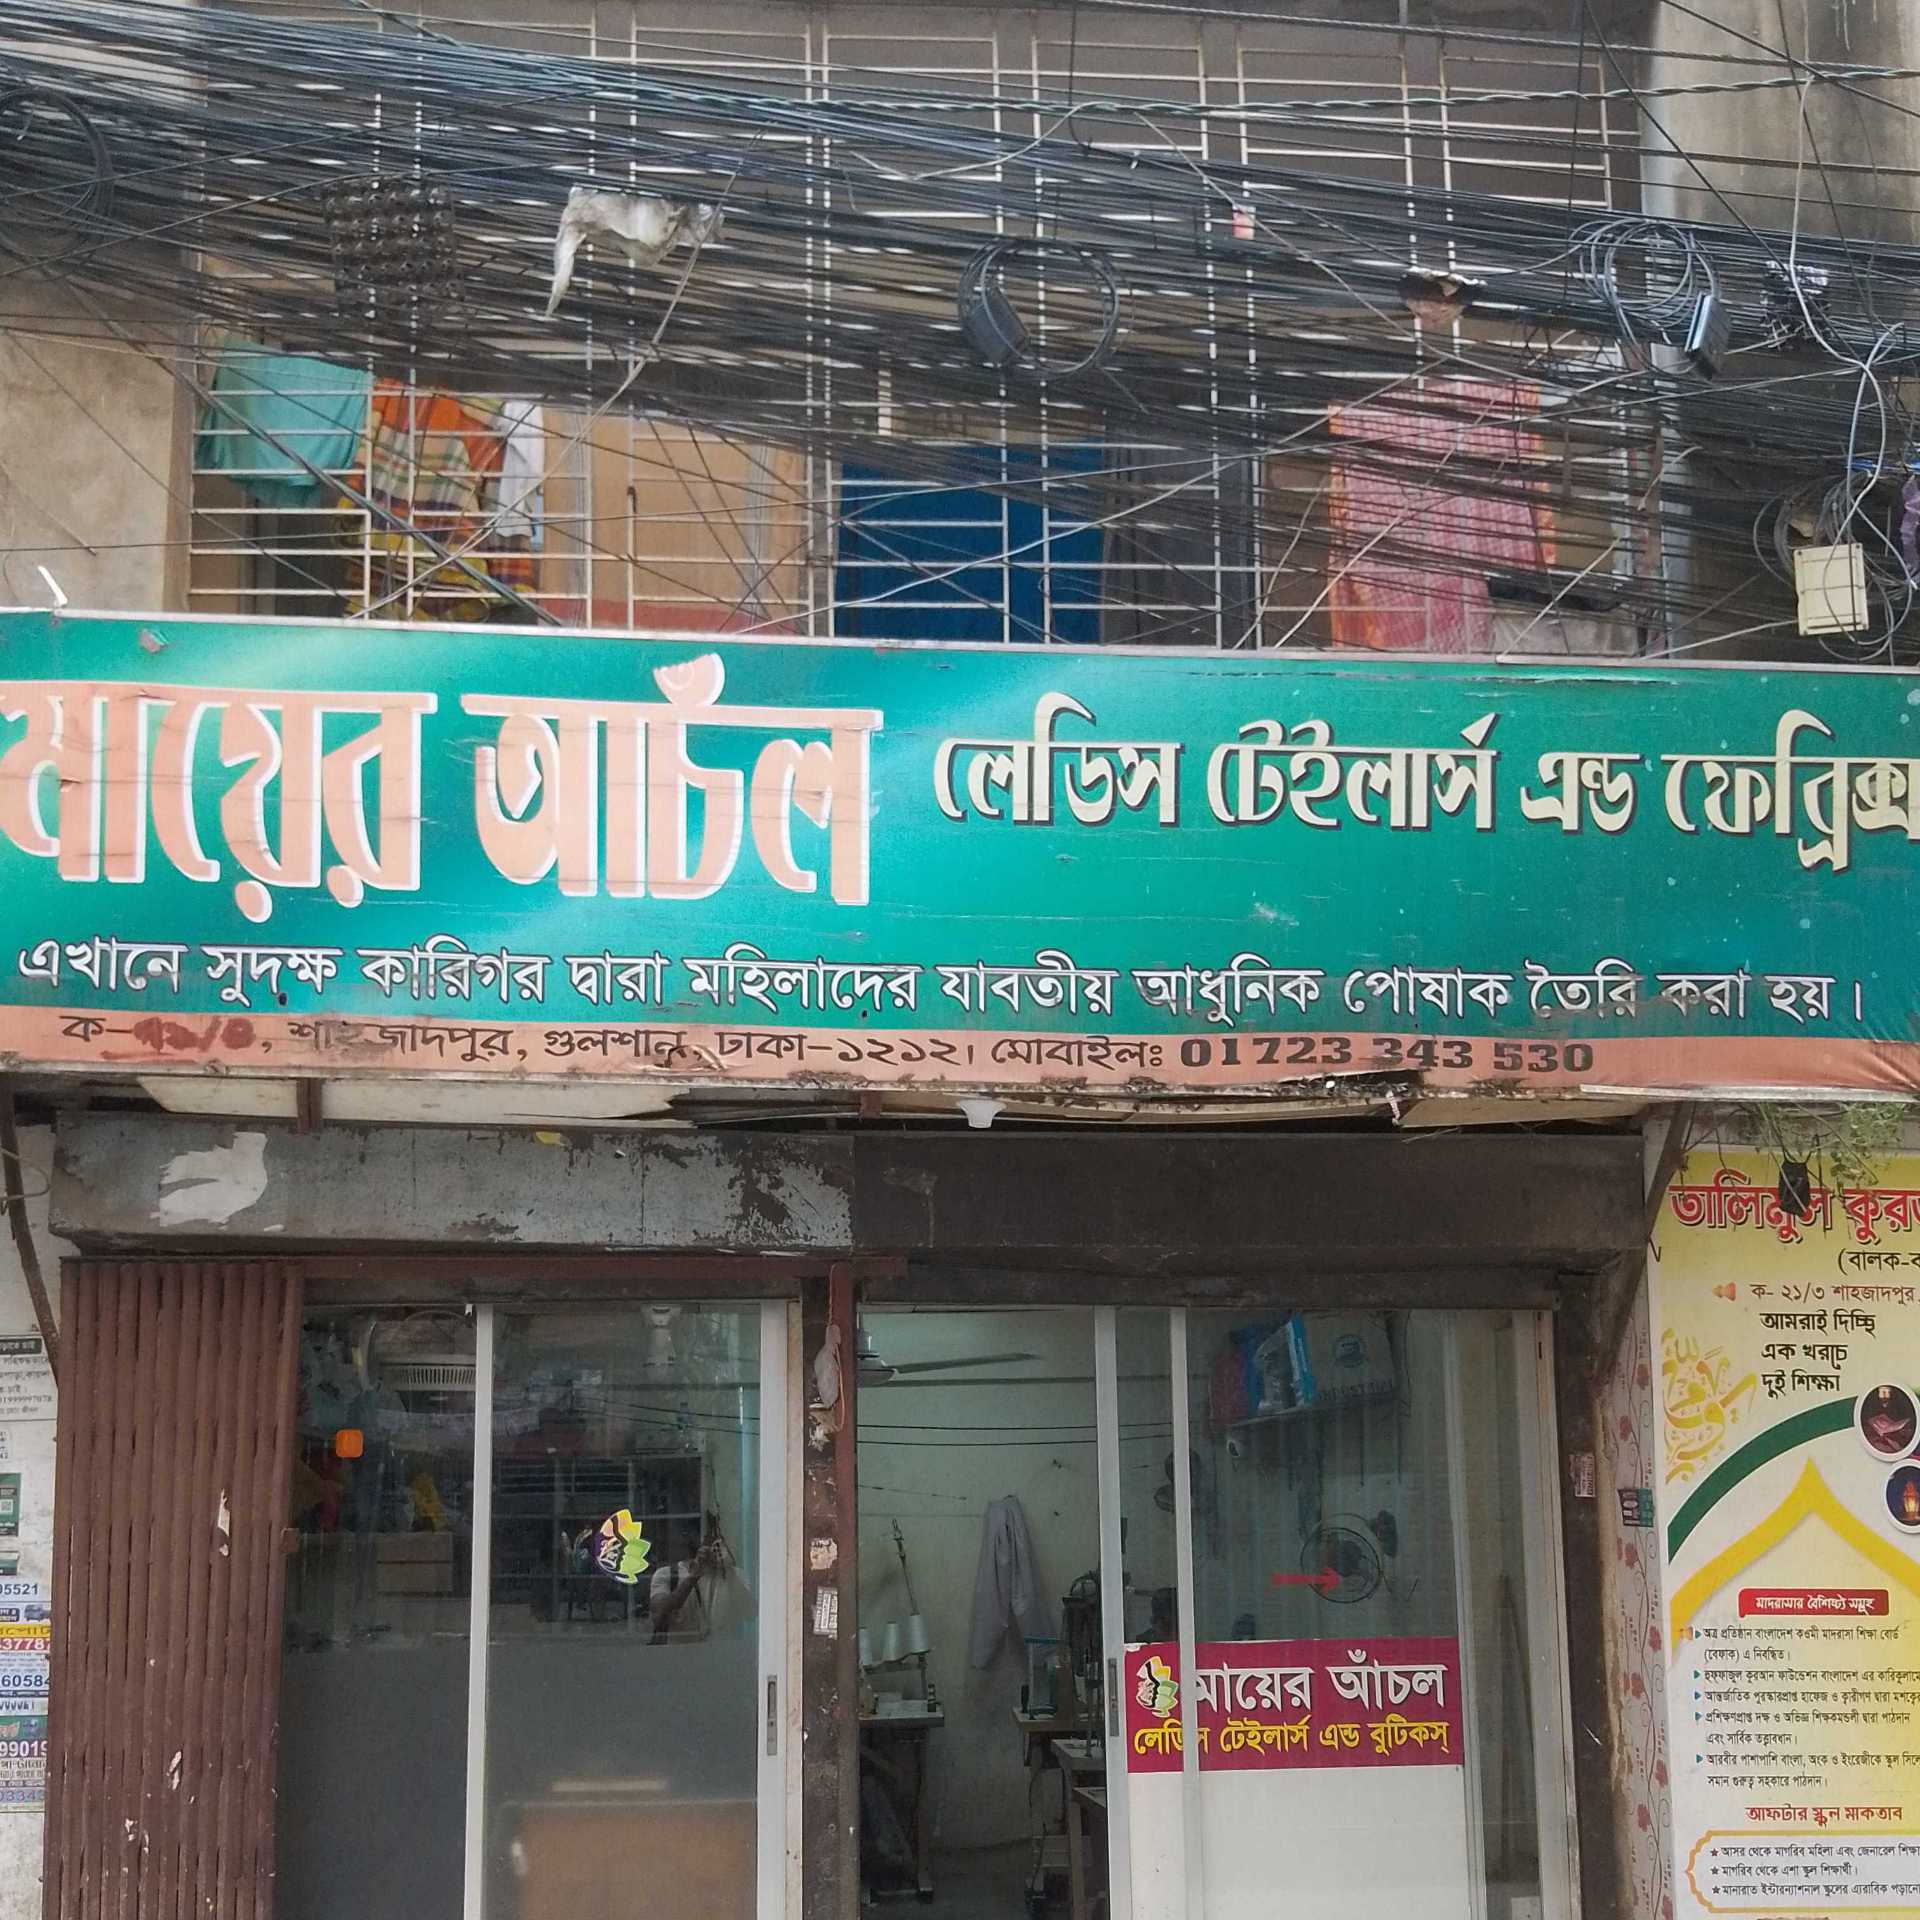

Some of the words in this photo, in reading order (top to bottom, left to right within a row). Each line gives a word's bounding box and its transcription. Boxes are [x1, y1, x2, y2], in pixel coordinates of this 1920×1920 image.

[934, 691, 1185, 826] লেডিস
[1207, 711, 1500, 831] টেইলার্স
[1520, 751, 1642, 833] এন্ড
[0, 681, 438, 923] মায়ের
[18, 935, 190, 992] এখানে
[200, 944, 344, 1007] সুদক্ষ
[356, 934, 552, 1003] কারিগর
[565, 948, 670, 1005] দ্বারা
[682, 941, 925, 1014] মহিলাদের
[935, 948, 1120, 1015] যাবতীয়
[1130, 952, 1325, 1027] আধুনিক
[1343, 964, 1514, 1018] পোষাক
[1524, 957, 1644, 1020] তৈরি
[1655, 967, 1751, 1019] করা
[1180, 1037, 1352, 1067] 01723
[1371, 1037, 1474, 1069] 343
[1493, 1042, 1594, 1073] 530
[1760, 1308, 1828, 1332] আমরাই
[1761, 1343, 1796, 1361] এক
[1802, 1341, 1848, 1371] খরচে
[1762, 1368, 1786, 1399] দুই
[1791, 1368, 1841, 1393] শিক্ষা
[1220, 1714, 1312, 1756] টেইলার্স
[1319, 1721, 1361, 1749] এন্ড
